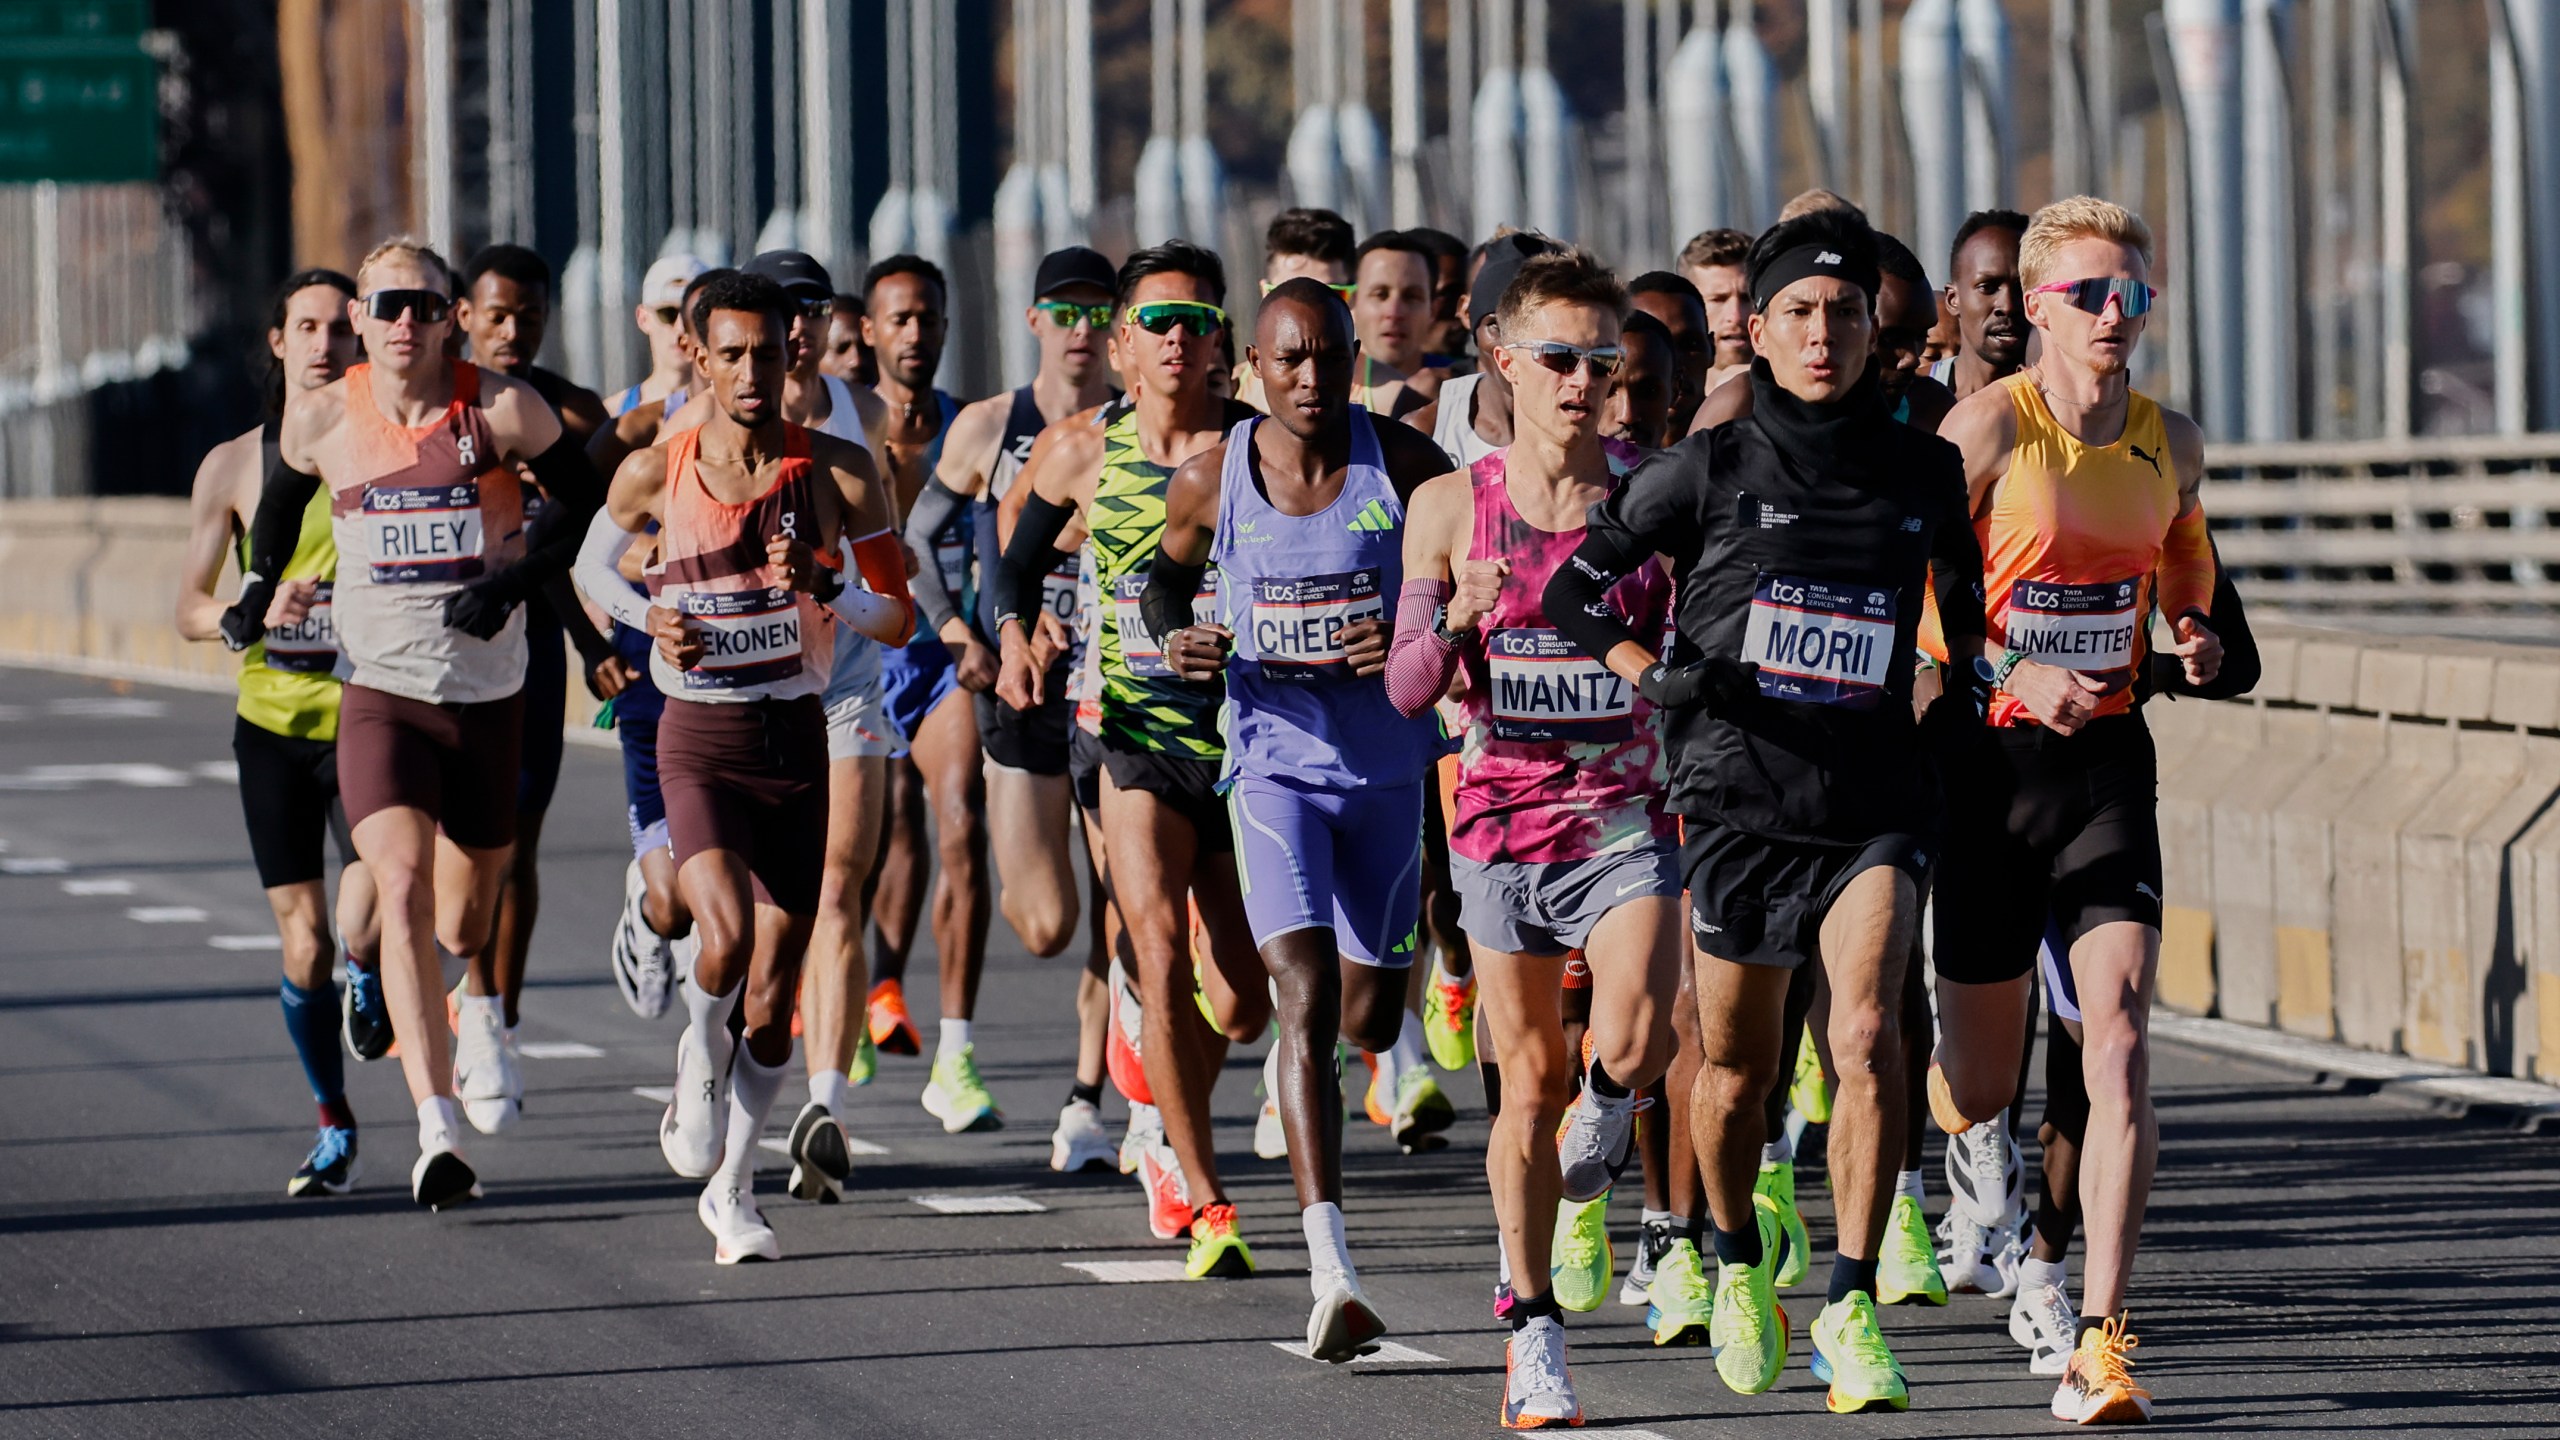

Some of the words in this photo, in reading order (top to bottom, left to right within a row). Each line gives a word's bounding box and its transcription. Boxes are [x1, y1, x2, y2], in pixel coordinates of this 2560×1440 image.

[373, 492, 402, 510] tcs
[383, 520, 466, 556] RILEY
[1264, 582, 1294, 601] tcs
[1295, 581, 1314, 589] TATA
[1351, 585, 1373, 596] TATA
[1771, 579, 1805, 604] tcs
[1809, 585, 1828, 594] TATA
[688, 597, 716, 614] tcs
[767, 599, 787, 608] TATA
[1806, 600, 1834, 609] SERVICES
[1807, 592, 1853, 604] CONSULTANCY
[2026, 586, 2060, 608] tcs
[2115, 598, 2131, 608] TATA
[1863, 606, 1886, 616] TATA
[1257, 607, 1381, 654] CHEB
[2008, 624, 2133, 654] LINKLETTER
[1503, 633, 1534, 655] tcs
[1766, 621, 1874, 676] MORII
[1502, 671, 1625, 713] MANTZ
